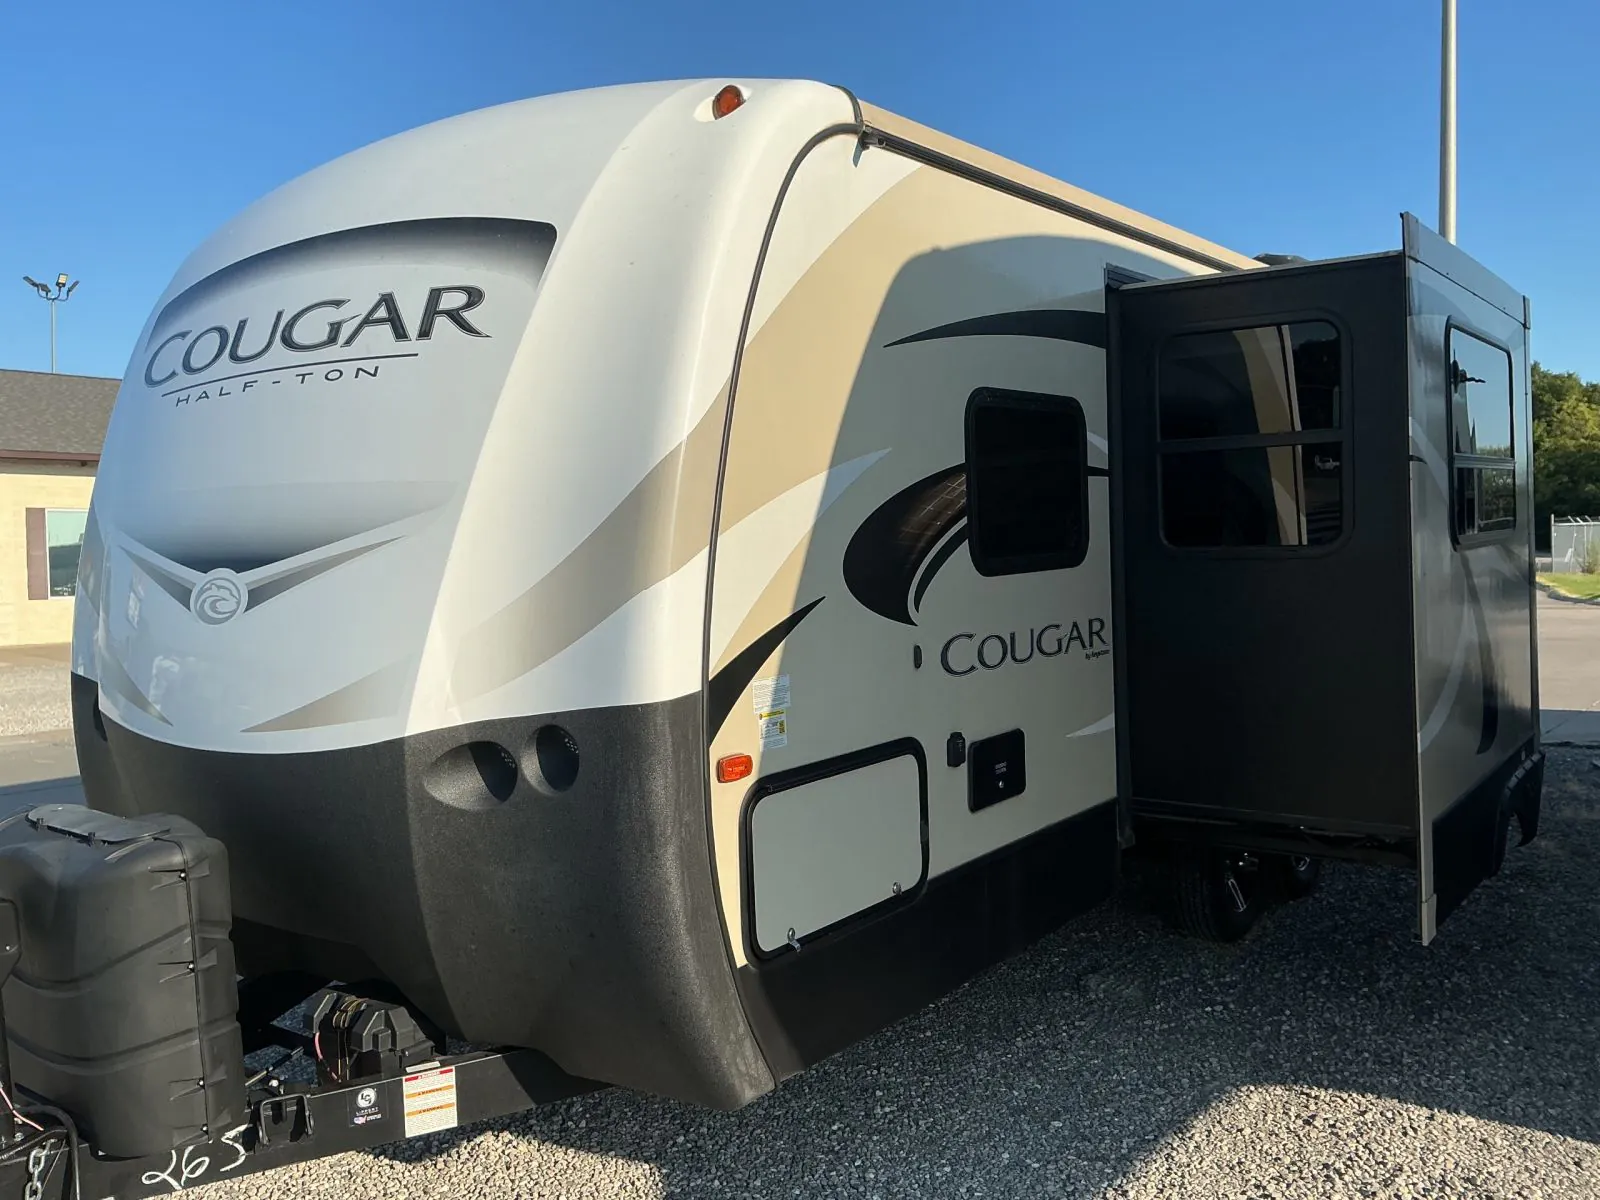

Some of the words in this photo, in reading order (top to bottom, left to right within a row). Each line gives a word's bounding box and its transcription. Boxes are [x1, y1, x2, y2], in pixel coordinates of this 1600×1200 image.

[144, 284, 492, 389] COUGAR
[175, 365, 380, 407] HALF-TON
[940, 617, 1109, 678] COUGAR
[141, 1123, 249, 1191] 265
